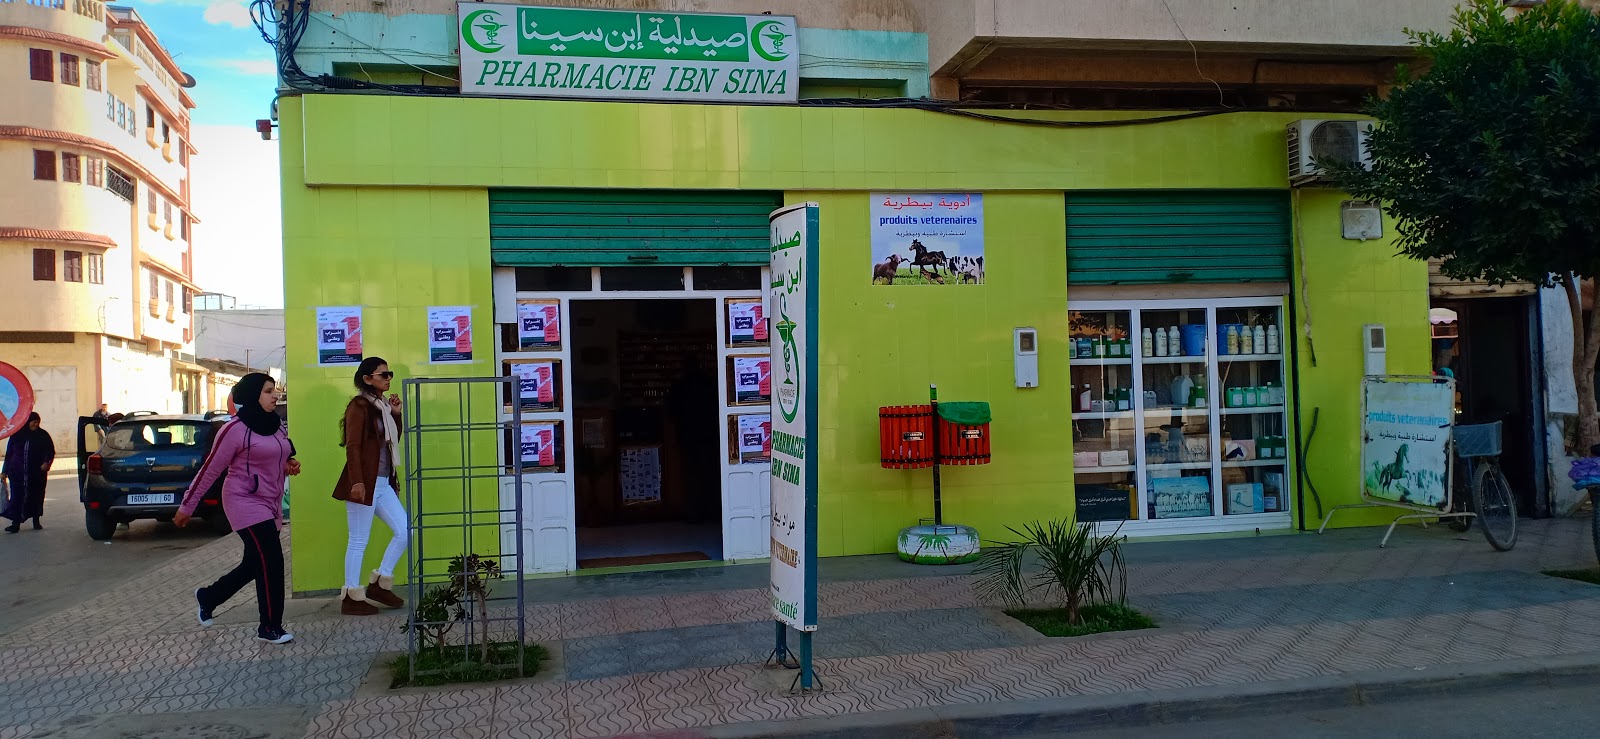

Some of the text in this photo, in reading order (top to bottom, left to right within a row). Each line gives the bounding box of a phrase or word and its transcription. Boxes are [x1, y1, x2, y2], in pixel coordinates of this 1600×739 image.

[520, 10, 746, 57] صيدلية إبن سينا
[475, 59, 788, 95] PHARMACIE IBN SINA
[883, 193, 971, 210] أدوية بيطرية
[880, 215, 978, 227] produits veterenaires
[787, 256, 802, 294] ابن
[1368, 410, 1396, 425] produits
[772, 430, 805, 459] PHARMACIE
[772, 458, 800, 485] IBN SINA
